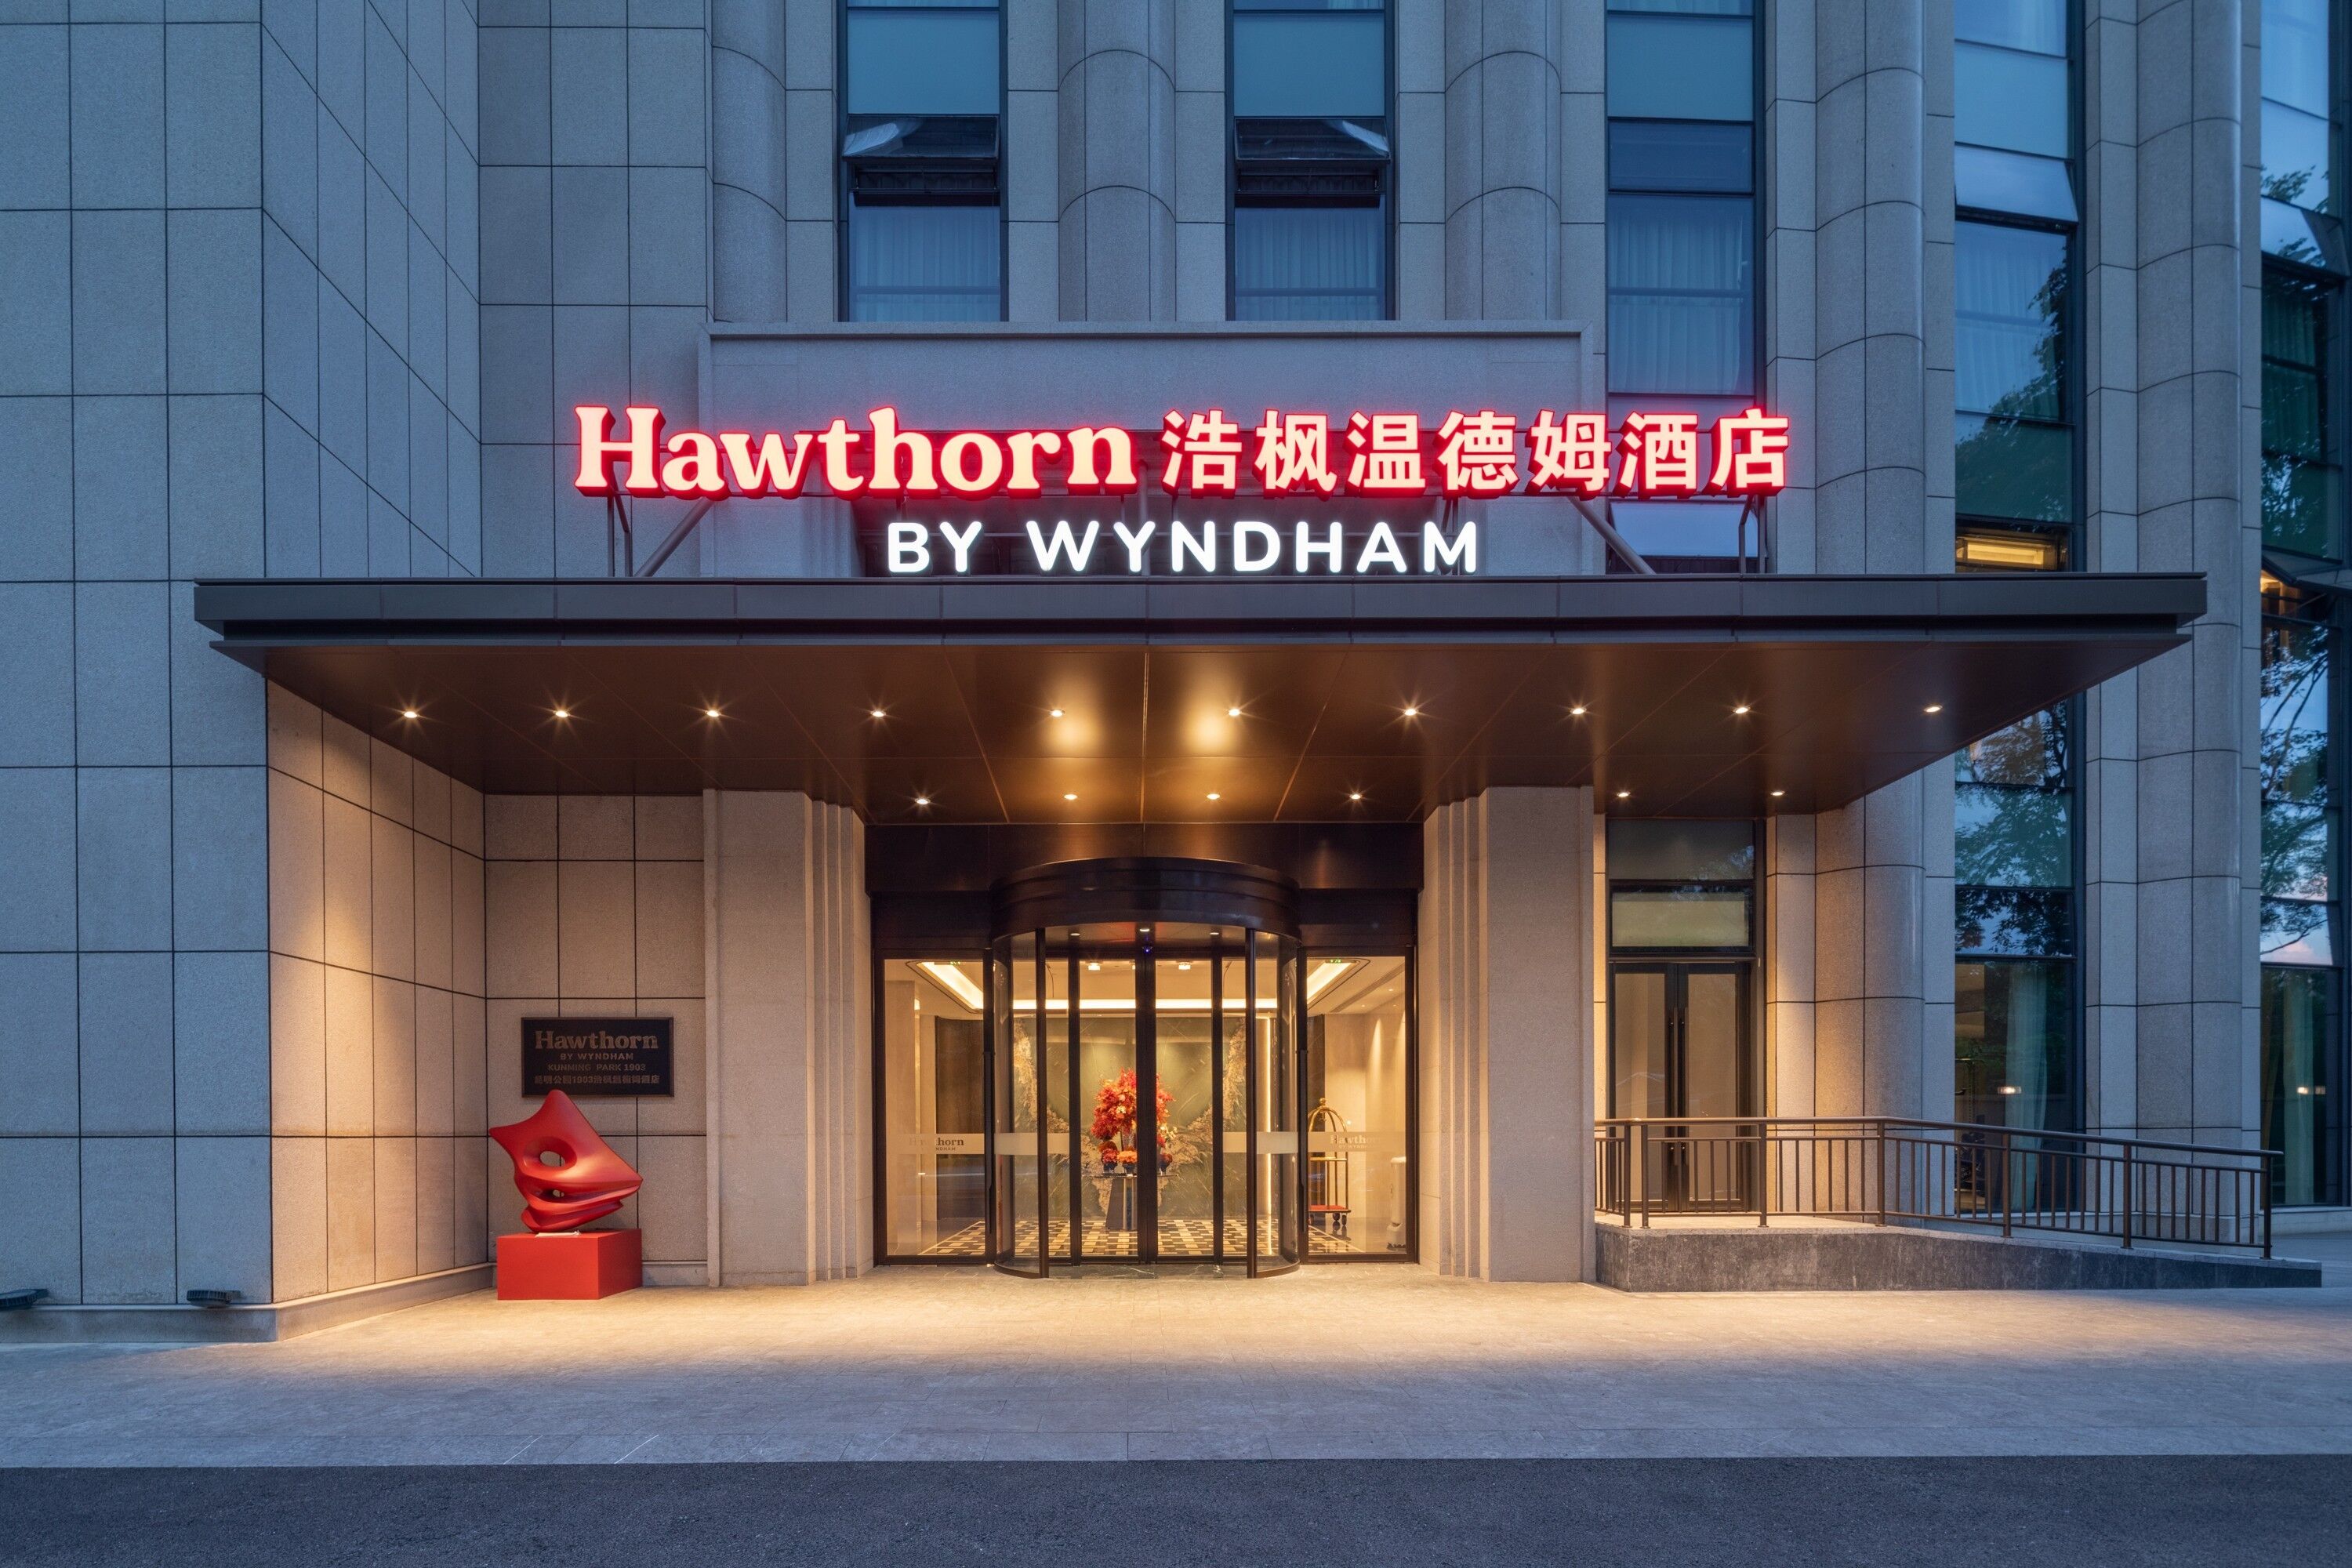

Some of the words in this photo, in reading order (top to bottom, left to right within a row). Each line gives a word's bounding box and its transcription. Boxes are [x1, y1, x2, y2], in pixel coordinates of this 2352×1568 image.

[574, 405, 1138, 496] Hawthorn
[1161, 408, 1790, 495] 浩枫温德姆酒店
[887, 521, 982, 573] BY
[1026, 521, 1477, 573] WYNDHAM
[535, 1030, 659, 1049] Hawthorn
